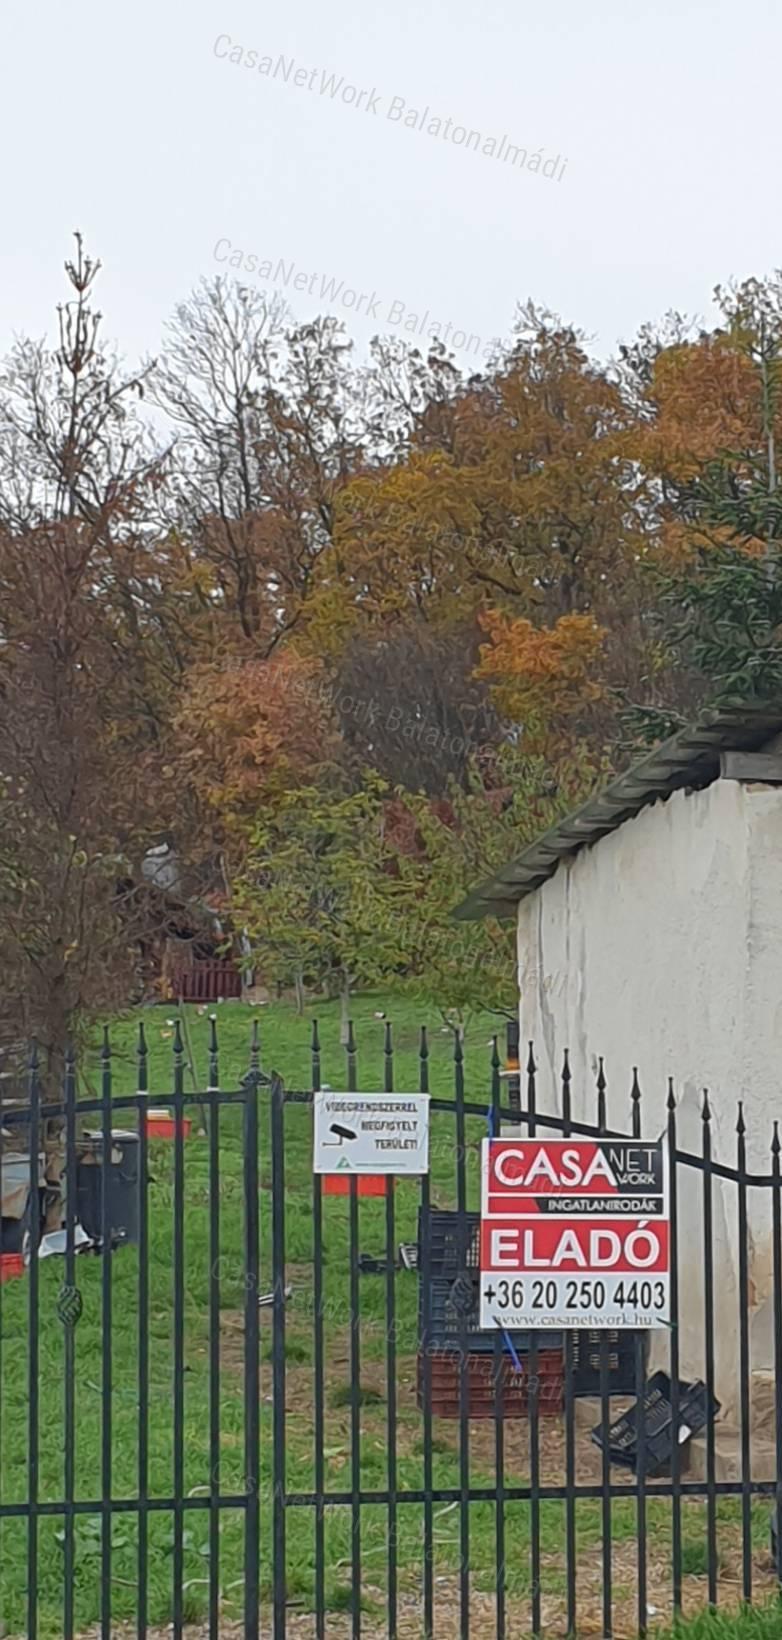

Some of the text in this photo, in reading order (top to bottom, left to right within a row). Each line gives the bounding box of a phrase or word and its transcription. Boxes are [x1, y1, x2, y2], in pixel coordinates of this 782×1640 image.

[494, 1147, 657, 1187] CASA NET
[616, 1172, 656, 1185] WORK
[548, 1197, 657, 1211] INGATLANIRODÁK
[490, 1220, 660, 1268] ELADÓ
[483, 1280, 666, 1310] +36 20 250 4403
[495, 1313, 653, 1327] www.casanetwork.hu
